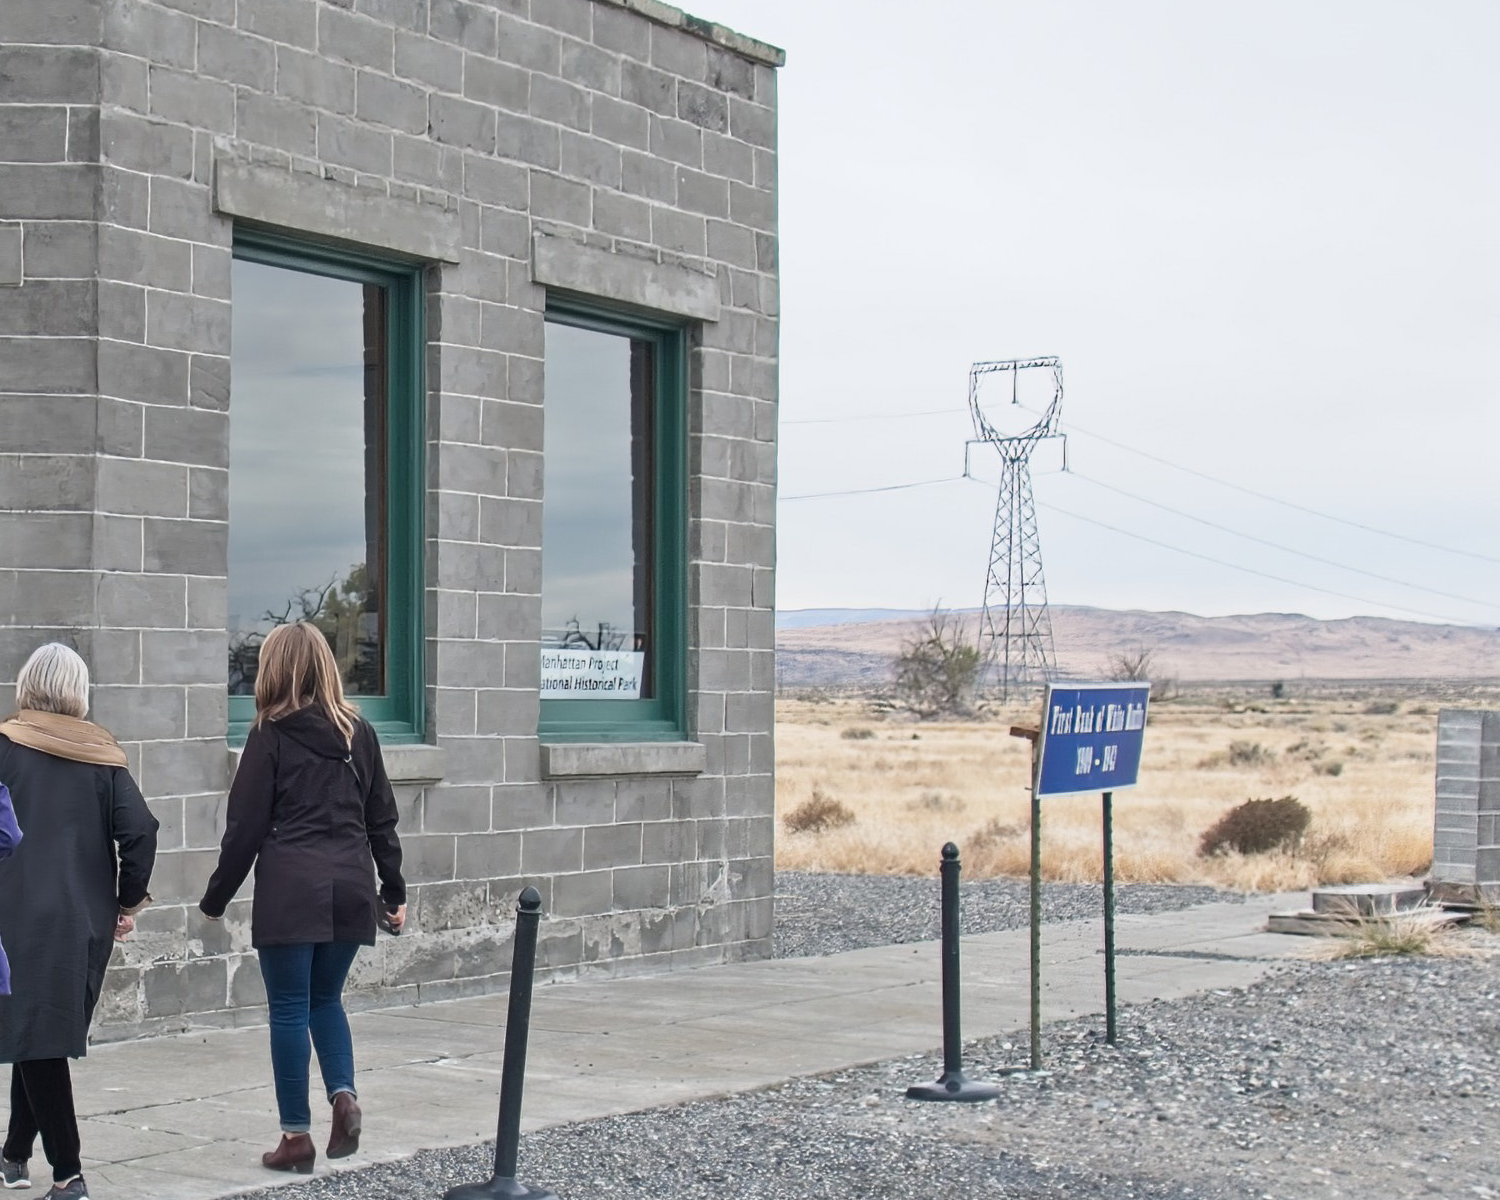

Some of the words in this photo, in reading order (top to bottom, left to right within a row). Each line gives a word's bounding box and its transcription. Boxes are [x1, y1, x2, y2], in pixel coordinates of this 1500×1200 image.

[588, 657, 619, 674] Project
[541, 676, 572, 690] ational
[574, 676, 617, 691] Historical
[618, 677, 638, 691] Park
[1051, 704, 1073, 735] First
